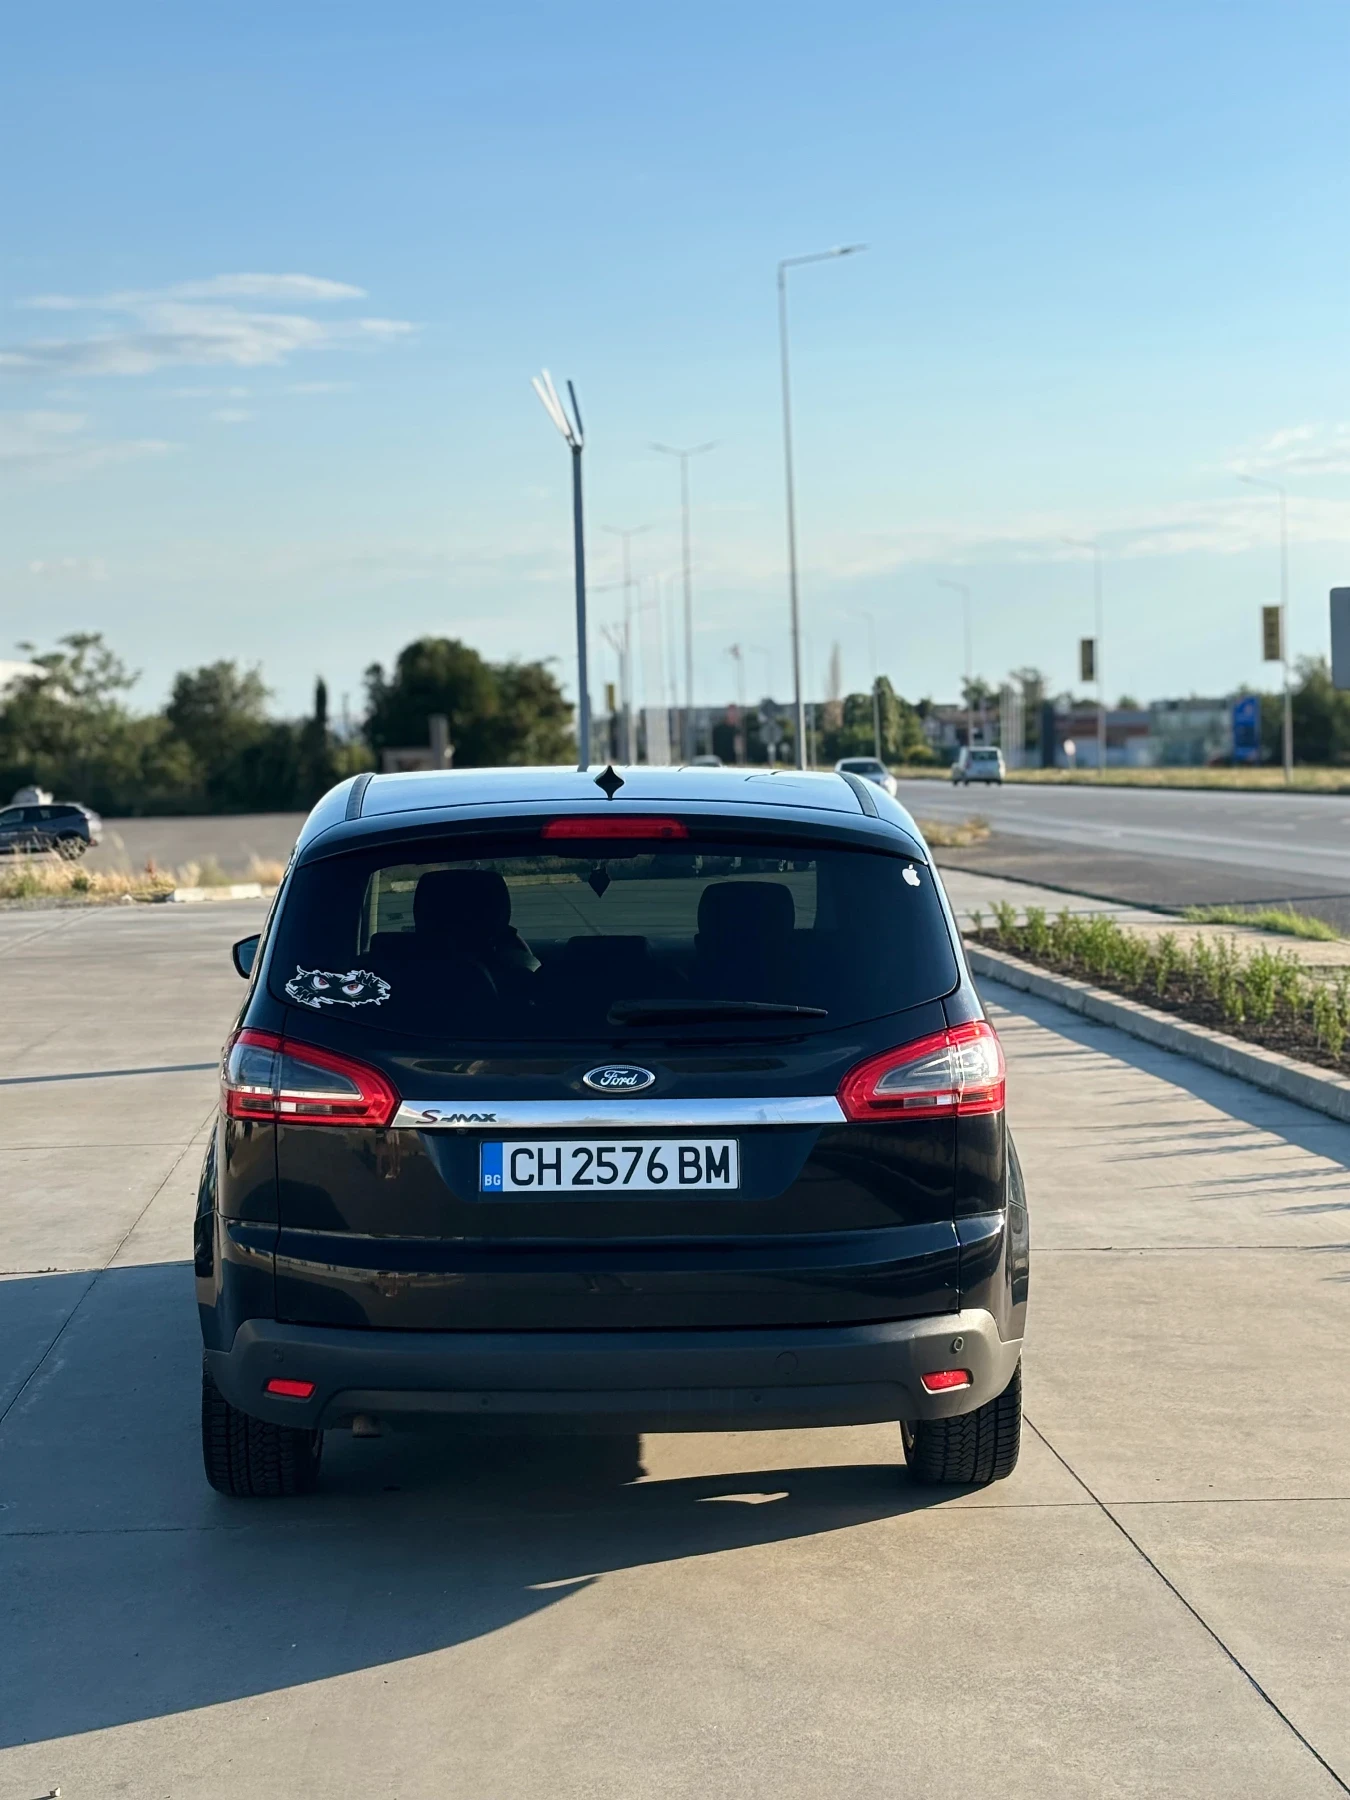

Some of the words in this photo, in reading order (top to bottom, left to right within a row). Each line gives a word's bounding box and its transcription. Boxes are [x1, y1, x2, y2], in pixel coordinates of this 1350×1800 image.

[600, 1069, 638, 1086] Ford
[415, 1109, 497, 1124] S-MAX
[510, 1147, 562, 1186] CH
[571, 1146, 669, 1185] 2576
[678, 1145, 730, 1184] BM
[484, 1174, 501, 1187] BG
